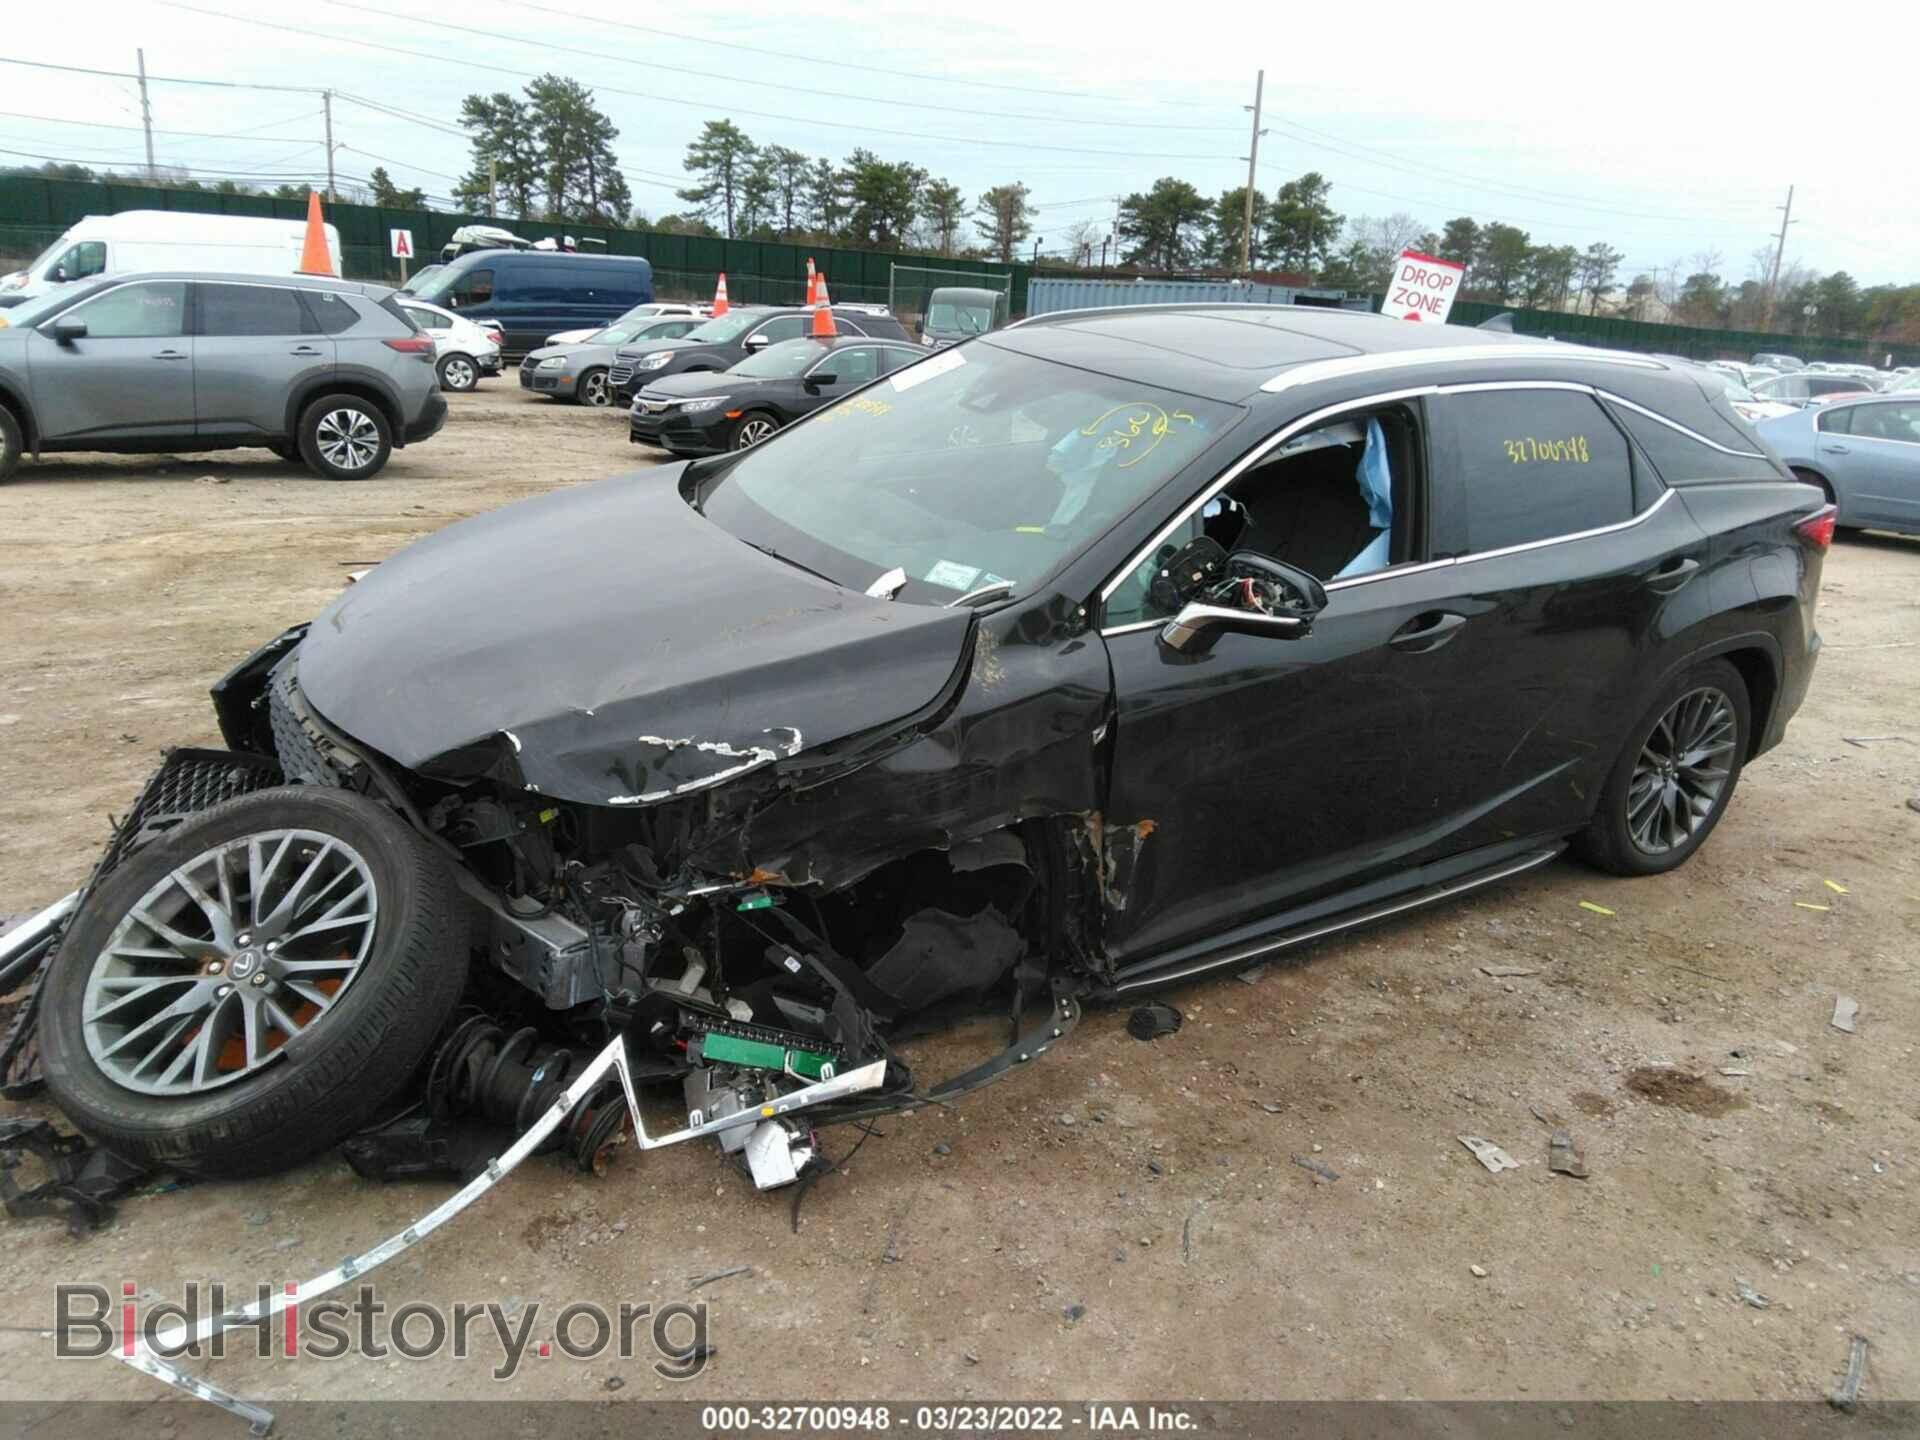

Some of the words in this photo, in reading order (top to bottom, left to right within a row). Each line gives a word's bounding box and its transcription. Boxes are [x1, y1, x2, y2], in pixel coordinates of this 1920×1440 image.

[396, 231, 410, 255] A
[1400, 265, 1454, 292] DROP
[1392, 286, 1446, 315] ZONE
